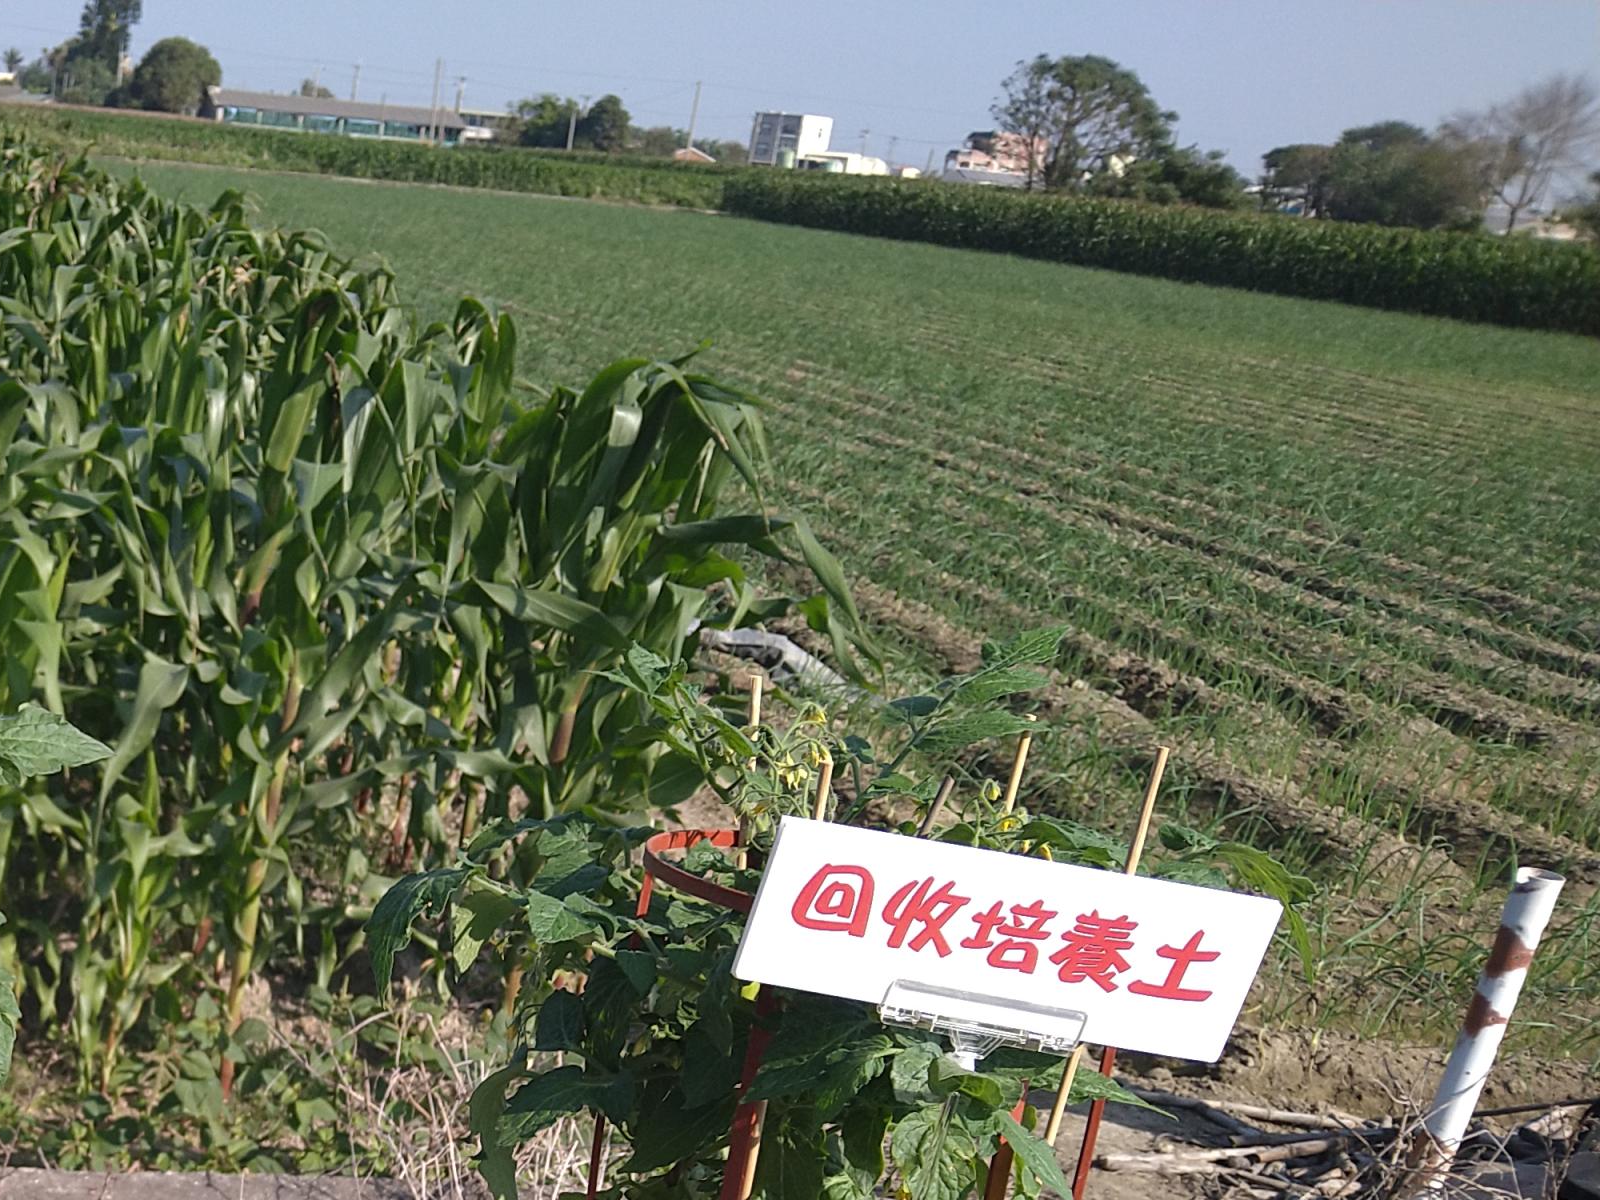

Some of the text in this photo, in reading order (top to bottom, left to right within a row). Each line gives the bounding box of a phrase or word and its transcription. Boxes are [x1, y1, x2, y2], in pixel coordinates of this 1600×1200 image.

[791, 863, 1221, 1002] 回收培養土
